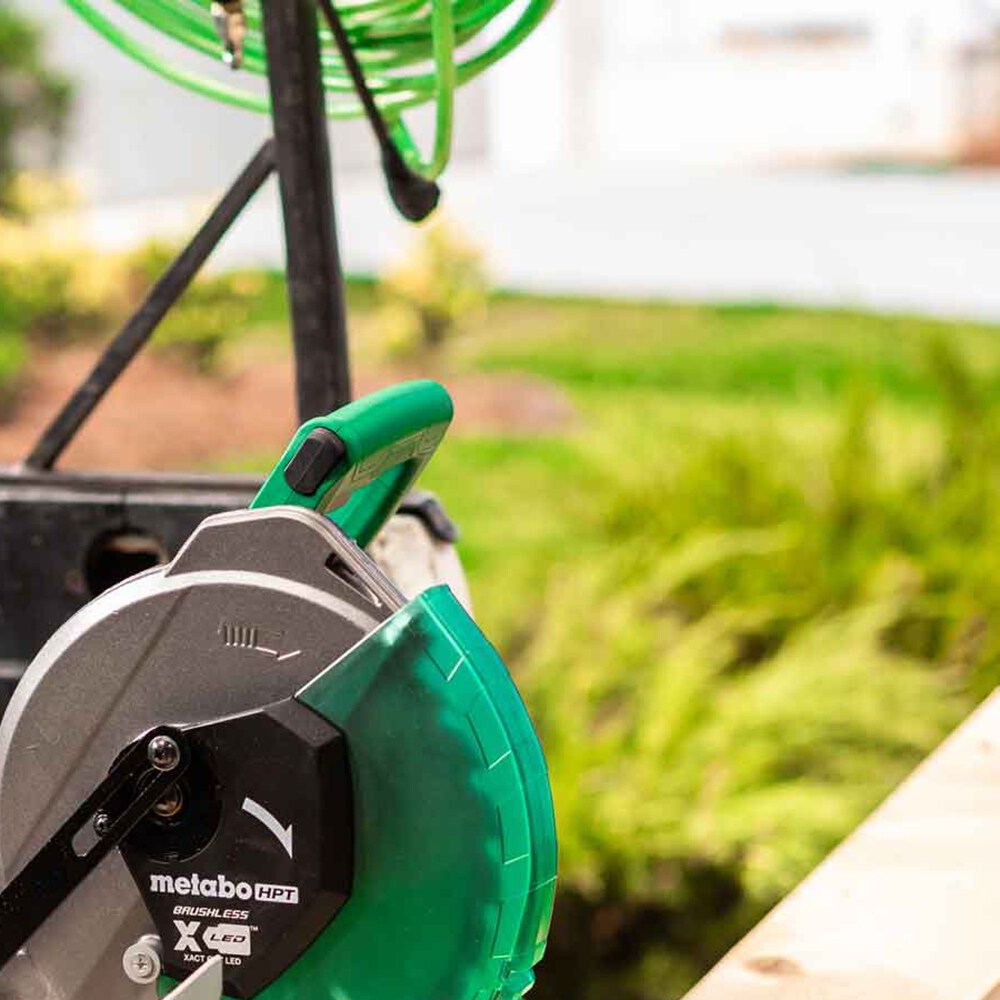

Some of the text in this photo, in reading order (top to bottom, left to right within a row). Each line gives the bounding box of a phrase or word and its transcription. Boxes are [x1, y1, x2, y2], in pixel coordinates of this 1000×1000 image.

[150, 873, 297, 901] metabo HPT
[173, 905, 249, 920] BRUSHLESS
[173, 920, 202, 952] X
[210, 934, 246, 943] LED
[184, 953, 204, 963] XACT
[225, 957, 241, 965] LED
